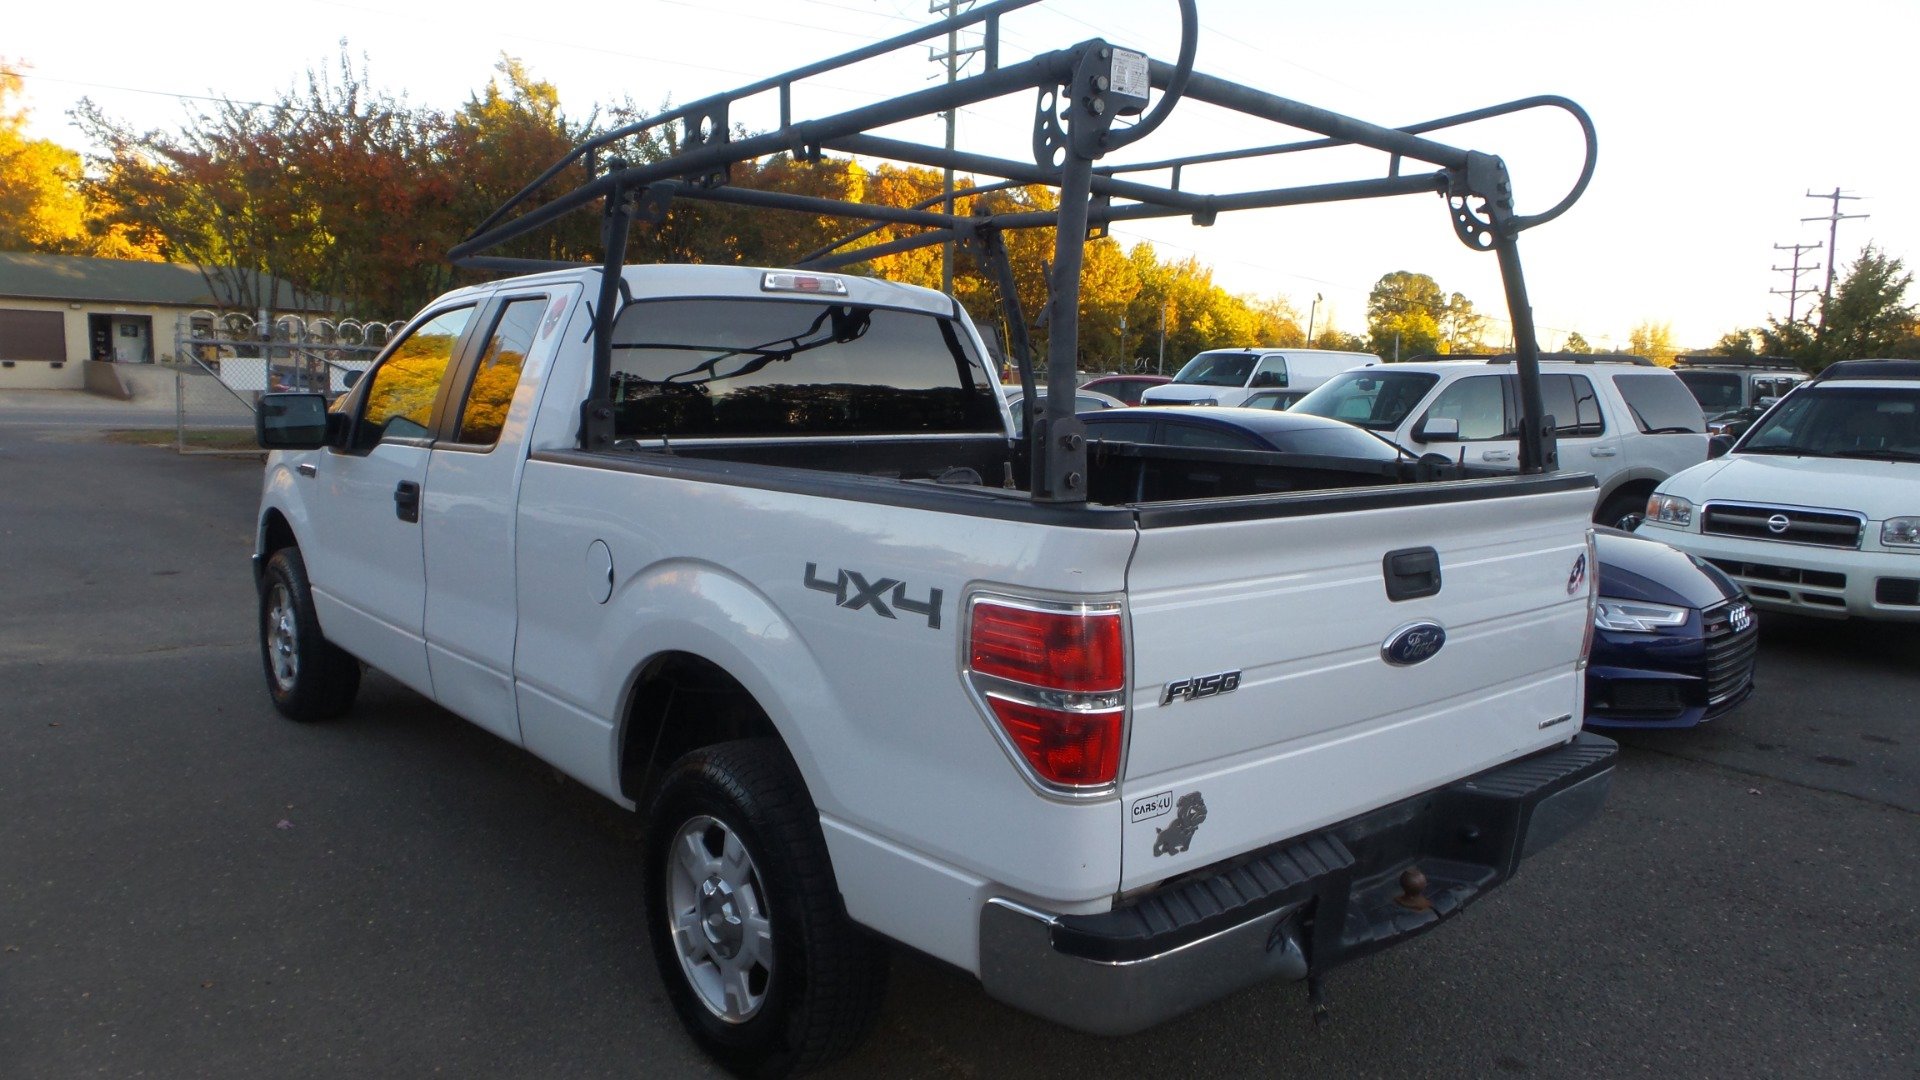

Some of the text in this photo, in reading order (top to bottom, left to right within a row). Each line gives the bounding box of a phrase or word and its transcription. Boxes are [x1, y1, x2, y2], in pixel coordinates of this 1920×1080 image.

[803, 561, 944, 631] 4X4
[1402, 630, 1439, 660] Ford
[1159, 670, 1242, 707] F-150
[1133, 801, 1157, 816] CARS
